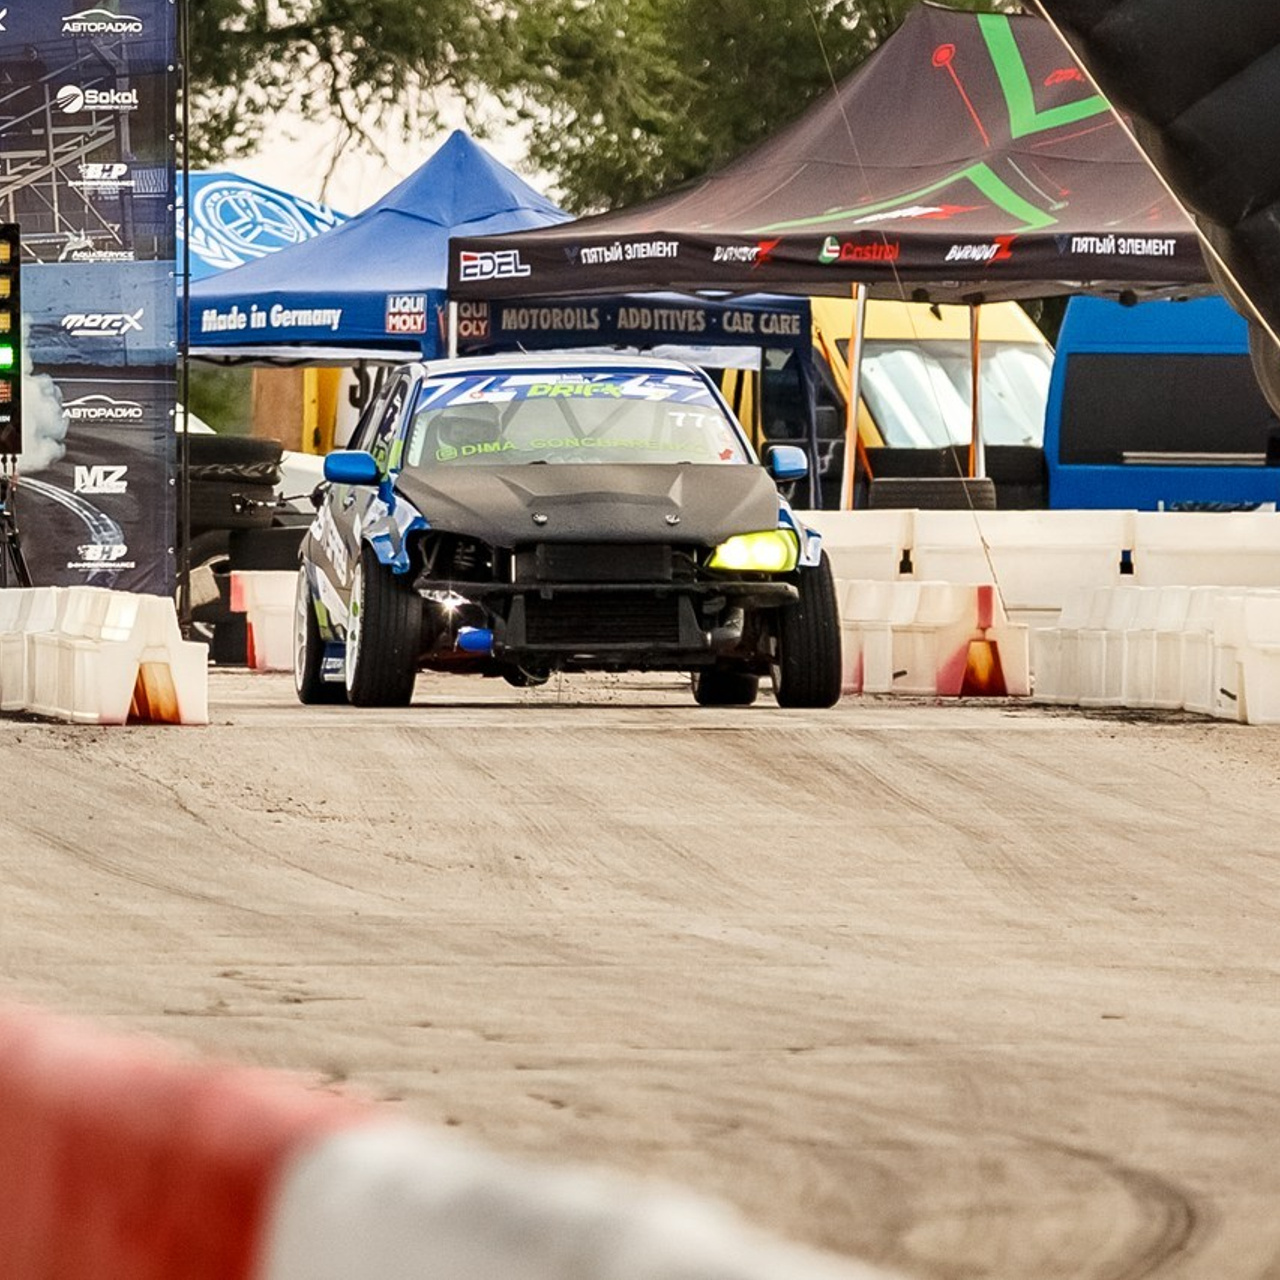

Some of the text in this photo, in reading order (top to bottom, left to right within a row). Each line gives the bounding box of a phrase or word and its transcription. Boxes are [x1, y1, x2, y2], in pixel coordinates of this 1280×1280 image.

[84, 89, 138, 104] Sokol
[581, 241, 678, 264] ПЯТЫЙ ЭЛЕМЕНТ
[839, 241, 899, 261] Castrol
[1071, 234, 1176, 256] ПЯТЫЙ ЭЛЕМЕНТ
[389, 297, 425, 313] LIQUI
[460, 302, 487, 318] QUI
[201, 303, 342, 332] Made in Germany
[388, 314, 425, 331] MOLY
[501, 307, 801, 335] MOTOROILS ADDITIVES CAR CARE
[459, 320, 487, 337] OLY
[462, 440, 517, 457] DIMA
